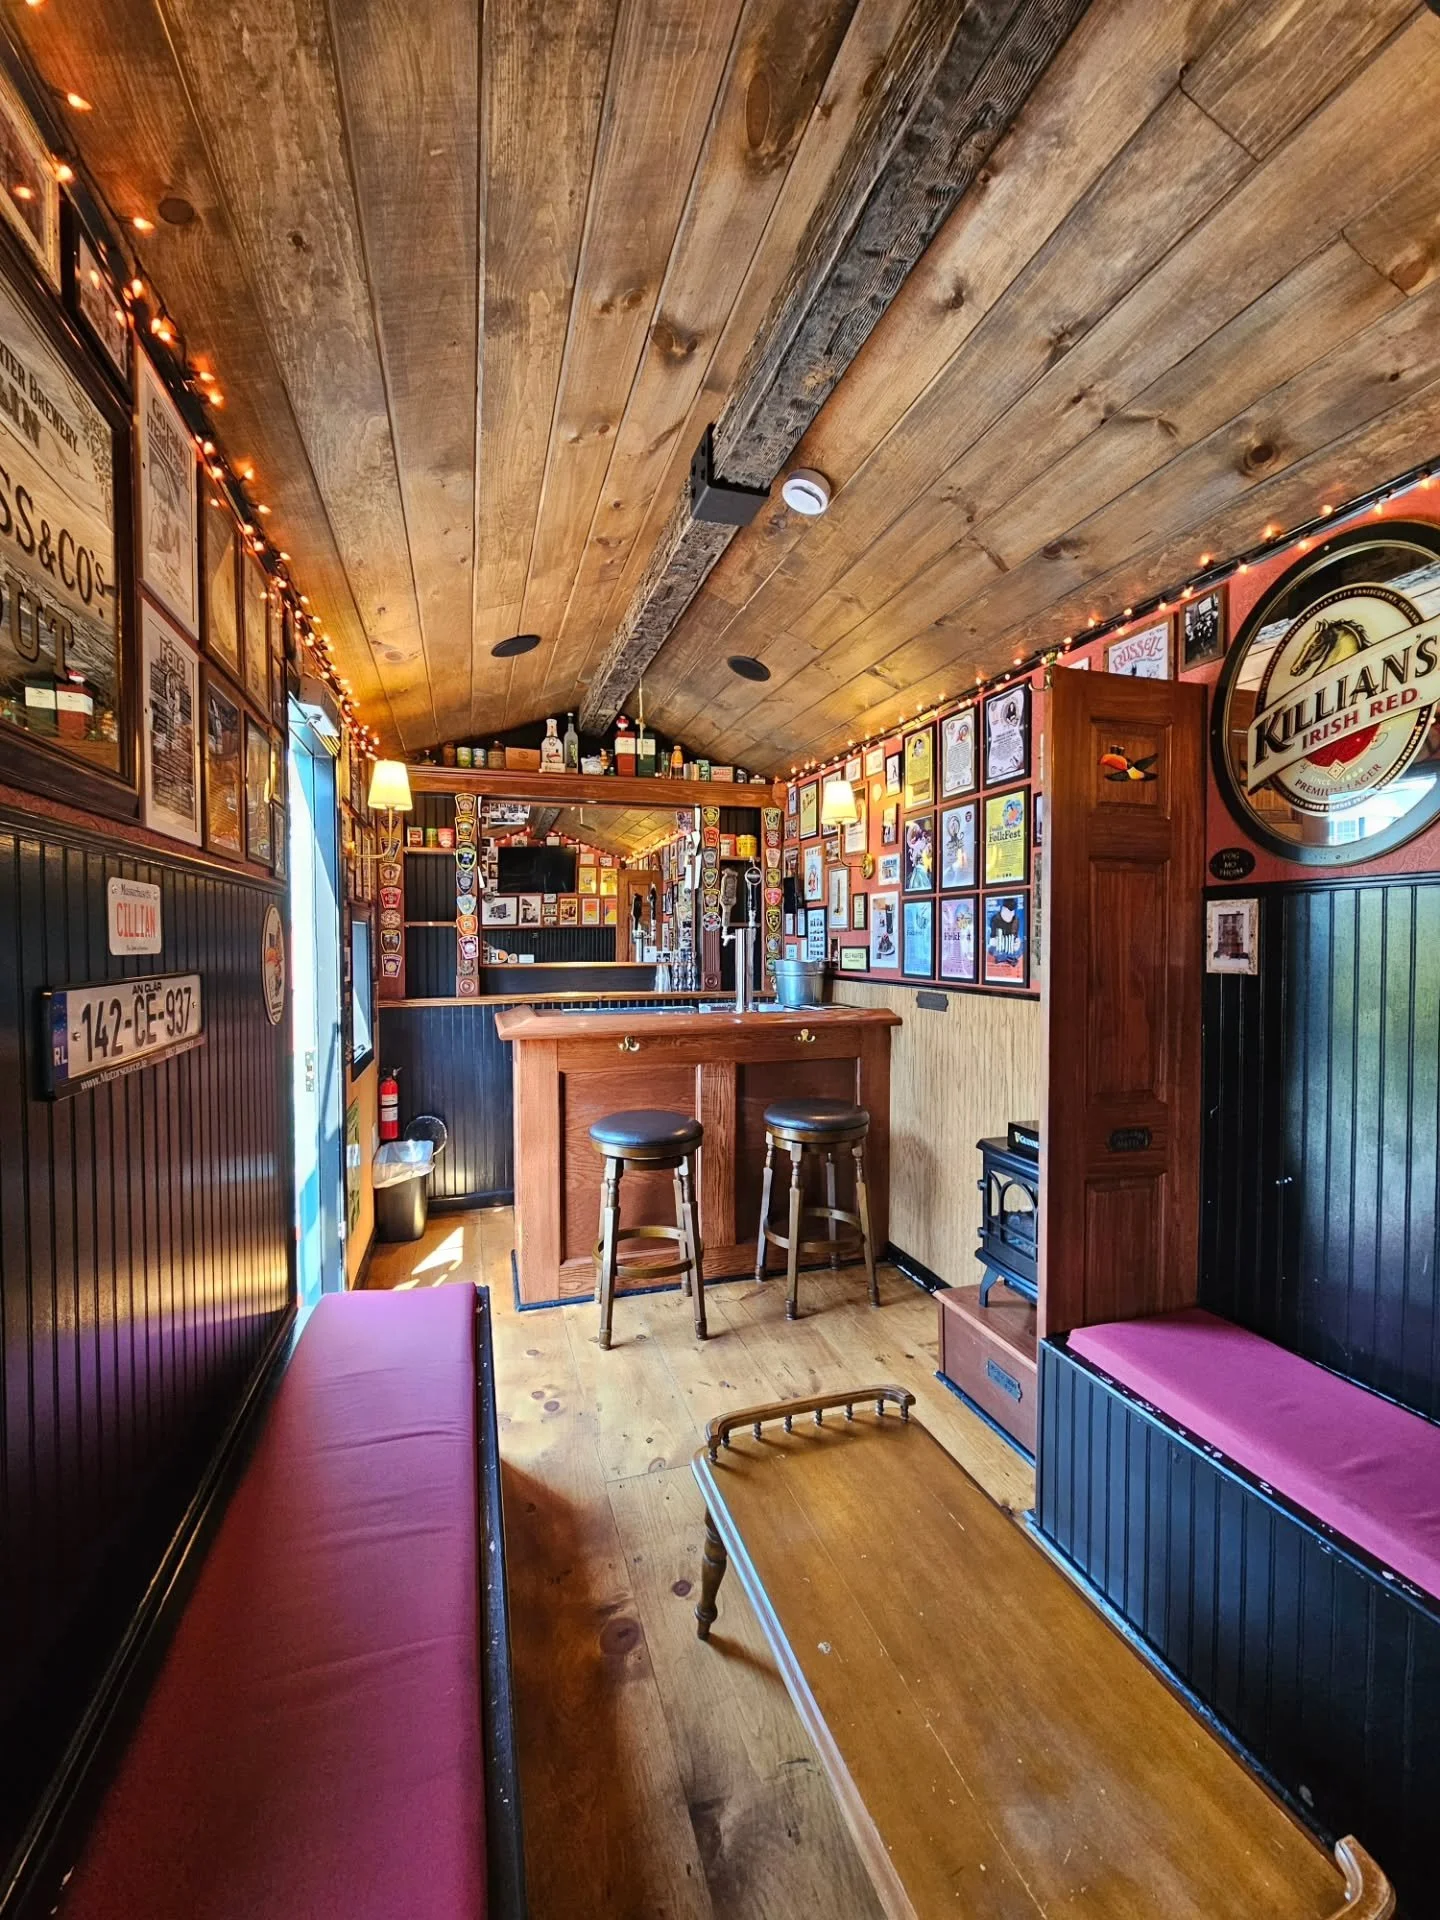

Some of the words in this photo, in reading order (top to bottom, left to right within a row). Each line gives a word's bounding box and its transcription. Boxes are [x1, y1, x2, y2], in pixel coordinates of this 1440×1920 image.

[0, 341, 26, 393] TER
[0, 571, 75, 682] UT
[1253, 633, 1438, 769] KILLIAN'S
[1302, 711, 1360, 750] IRISH
[1369, 687, 1418, 718] RED
[1347, 763, 1382, 789] LAGER
[989, 830, 1021, 842] FolkFest
[116, 902, 156, 938] CILLIAN
[132, 983, 143, 995] AN
[82, 986, 192, 1063] 142-CE-937
[53, 1045, 68, 1067] RL
